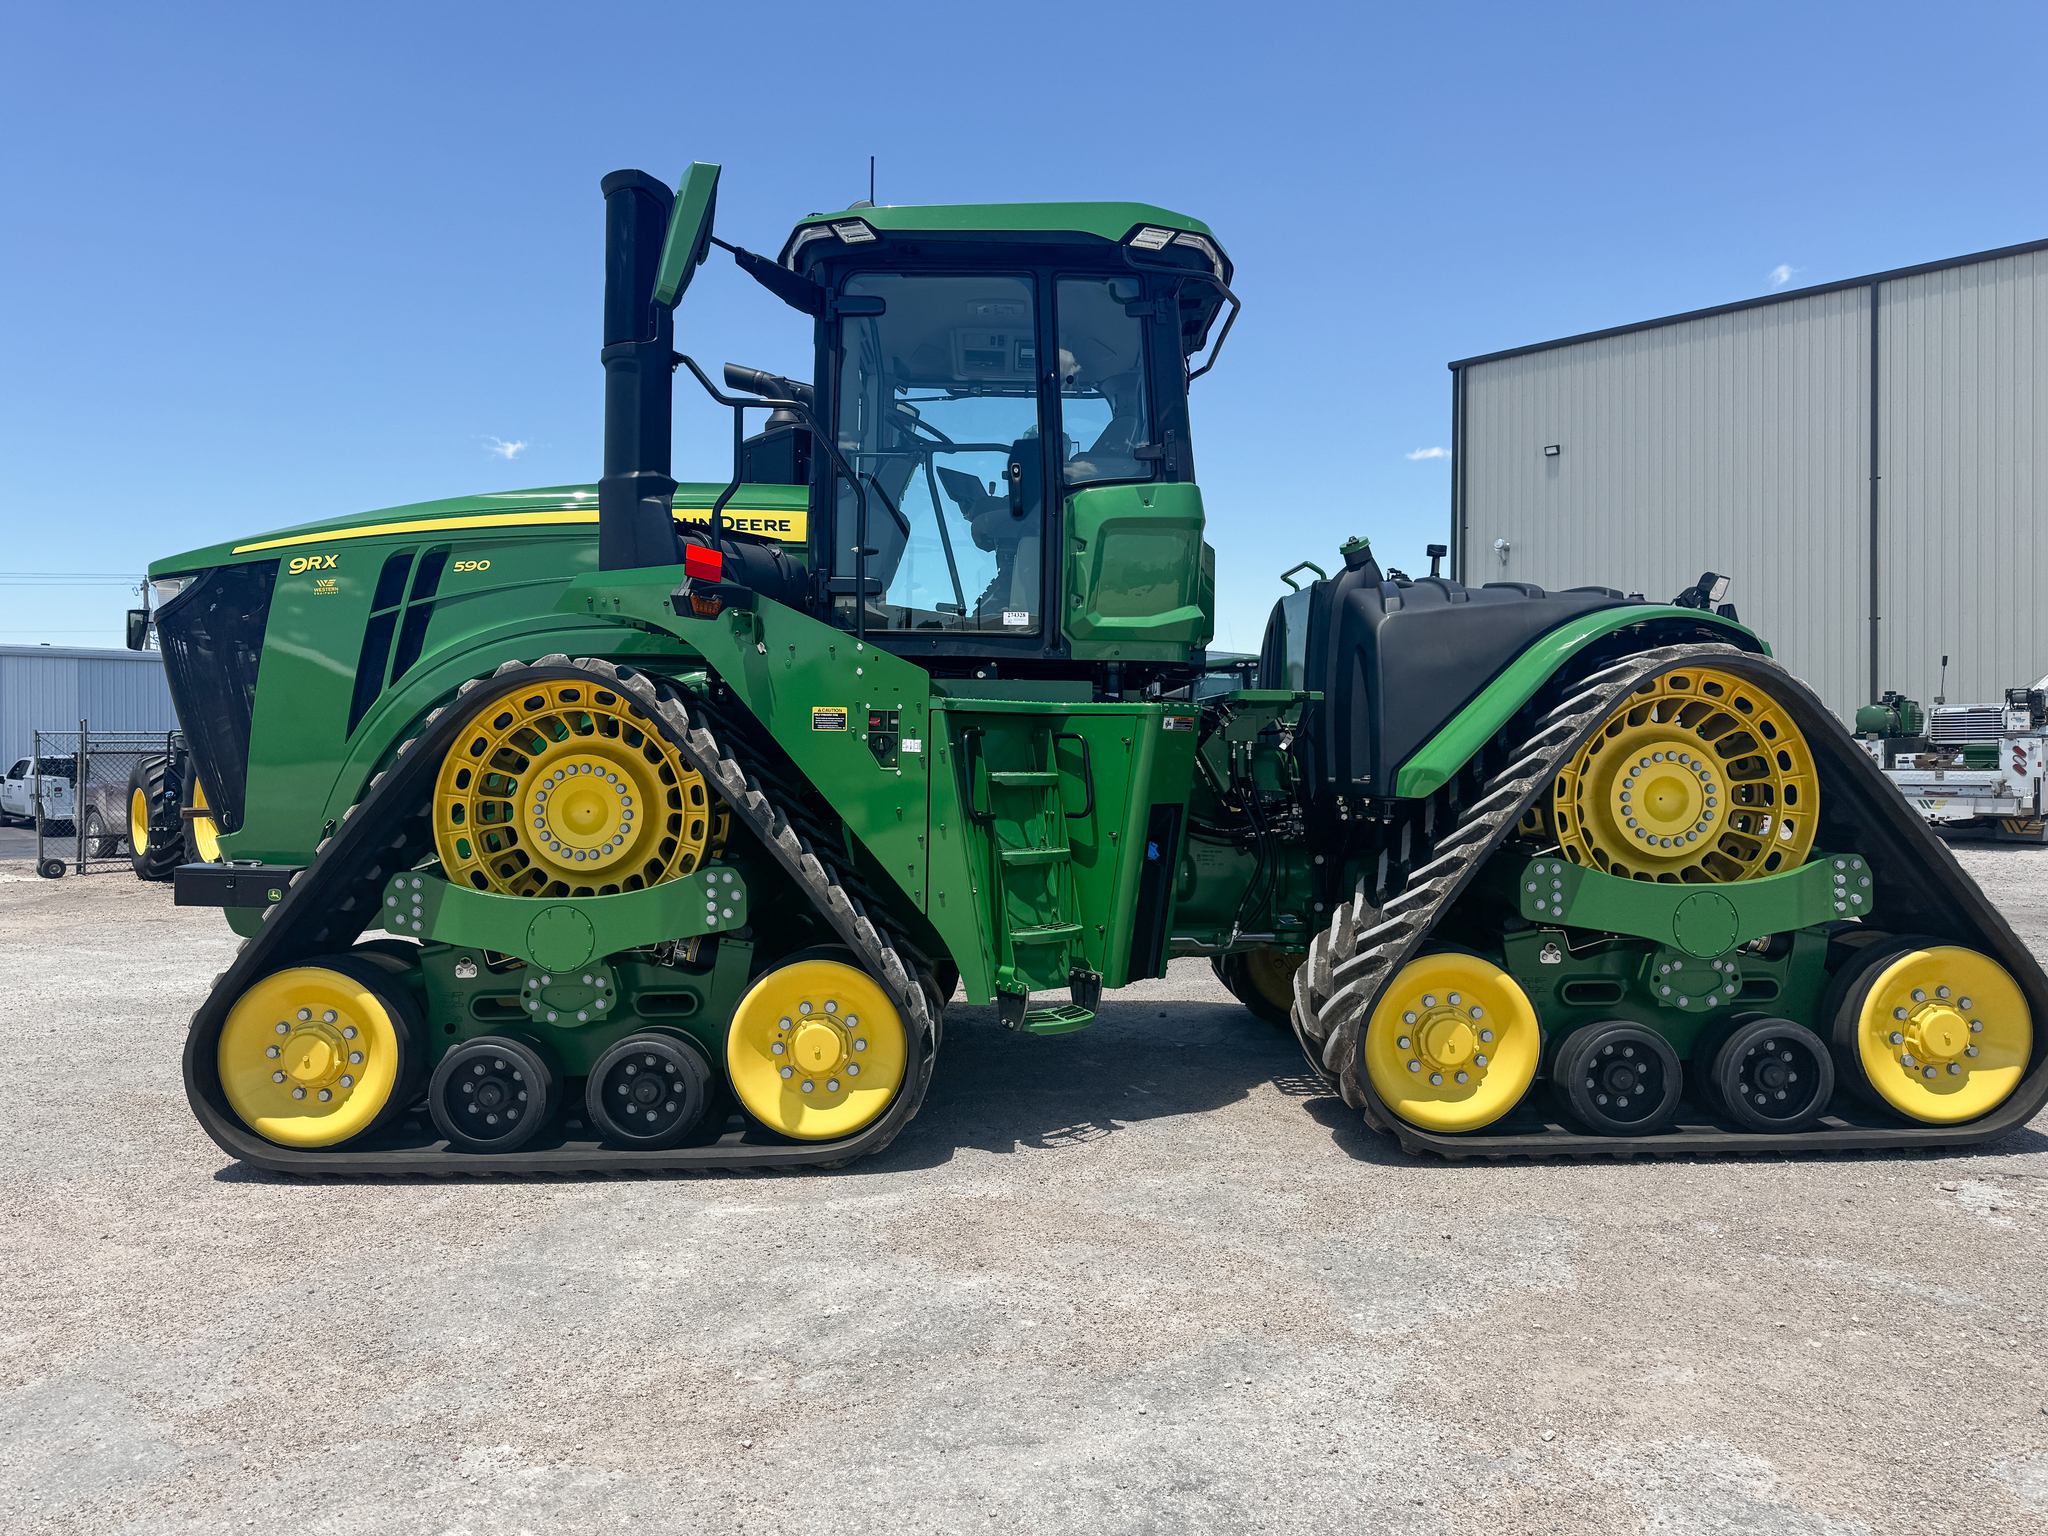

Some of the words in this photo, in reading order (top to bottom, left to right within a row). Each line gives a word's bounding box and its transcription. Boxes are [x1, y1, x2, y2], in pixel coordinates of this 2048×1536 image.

[720, 516, 791, 532] DEERE
[289, 554, 340, 575] 9RX
[453, 560, 491, 572] 590
